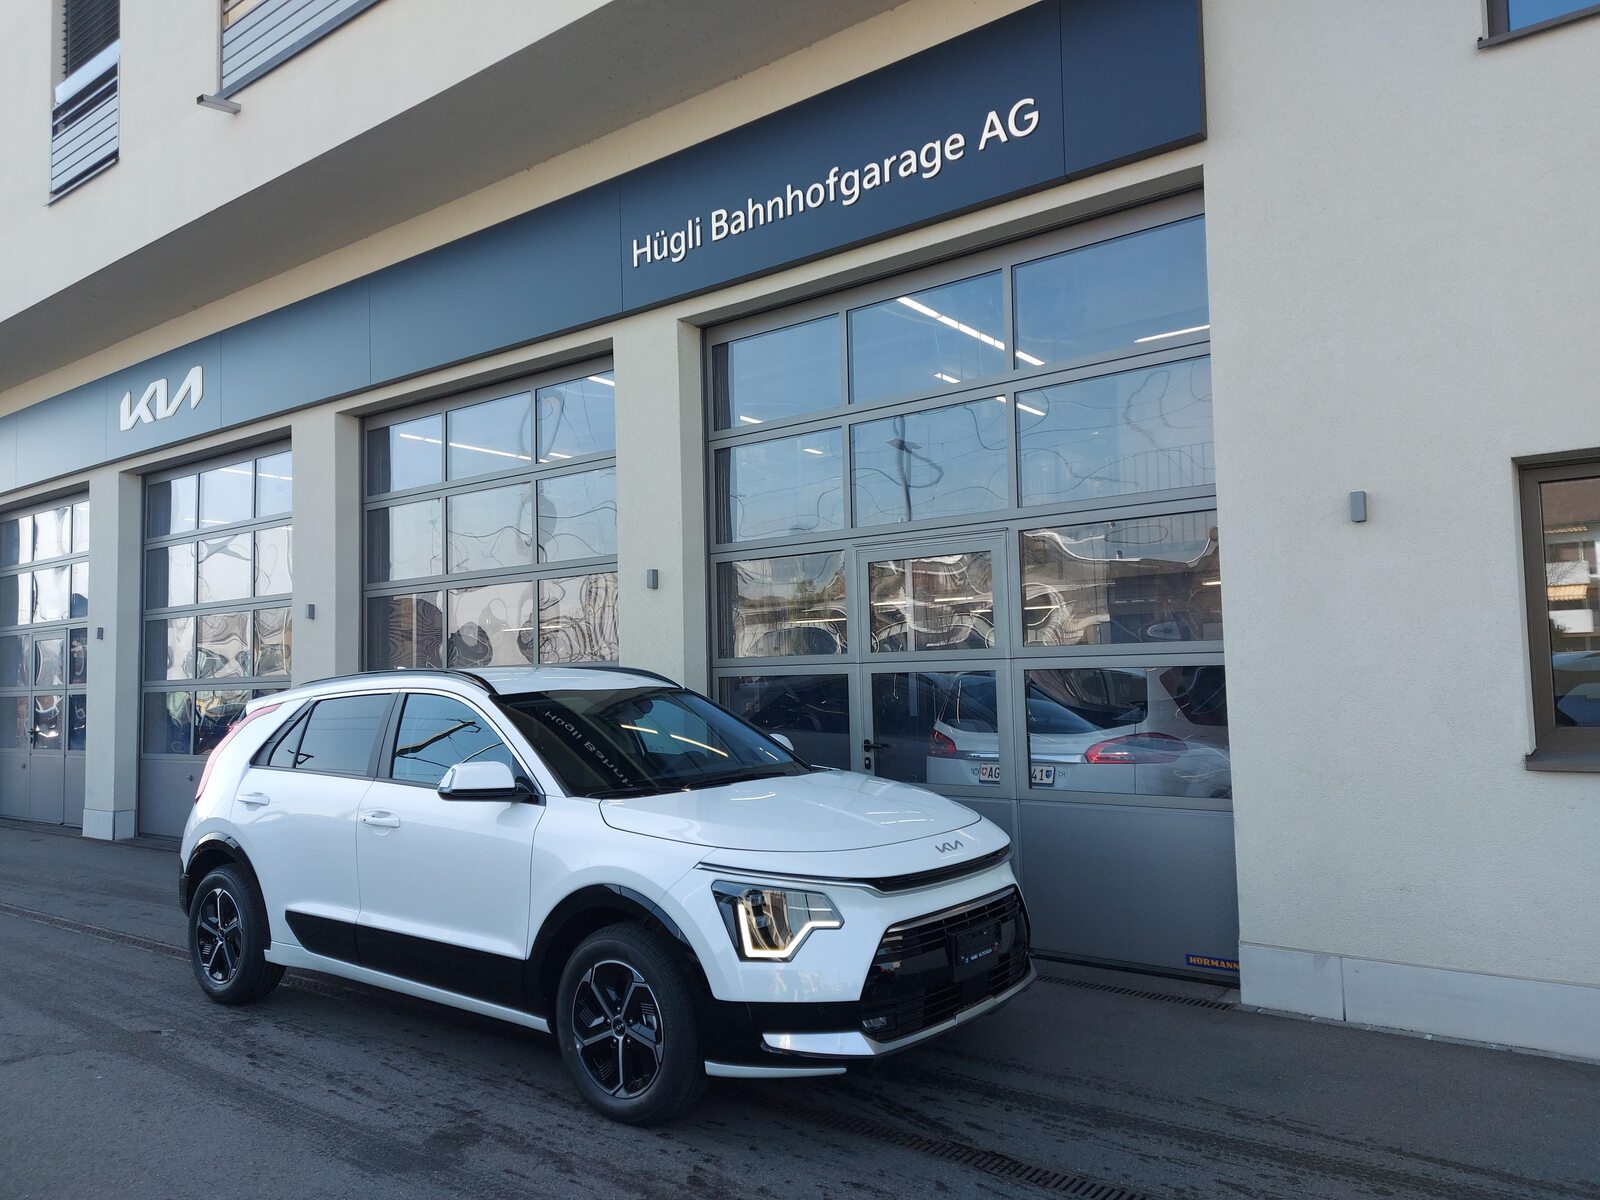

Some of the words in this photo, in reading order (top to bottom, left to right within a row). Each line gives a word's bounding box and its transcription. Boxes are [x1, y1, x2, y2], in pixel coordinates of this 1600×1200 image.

[632, 217, 701, 268] Hügli
[711, 131, 966, 242] Bahnhofgarage
[978, 97, 1041, 151] AG
[120, 365, 204, 432] KIA
[988, 766, 1000, 779] AG
